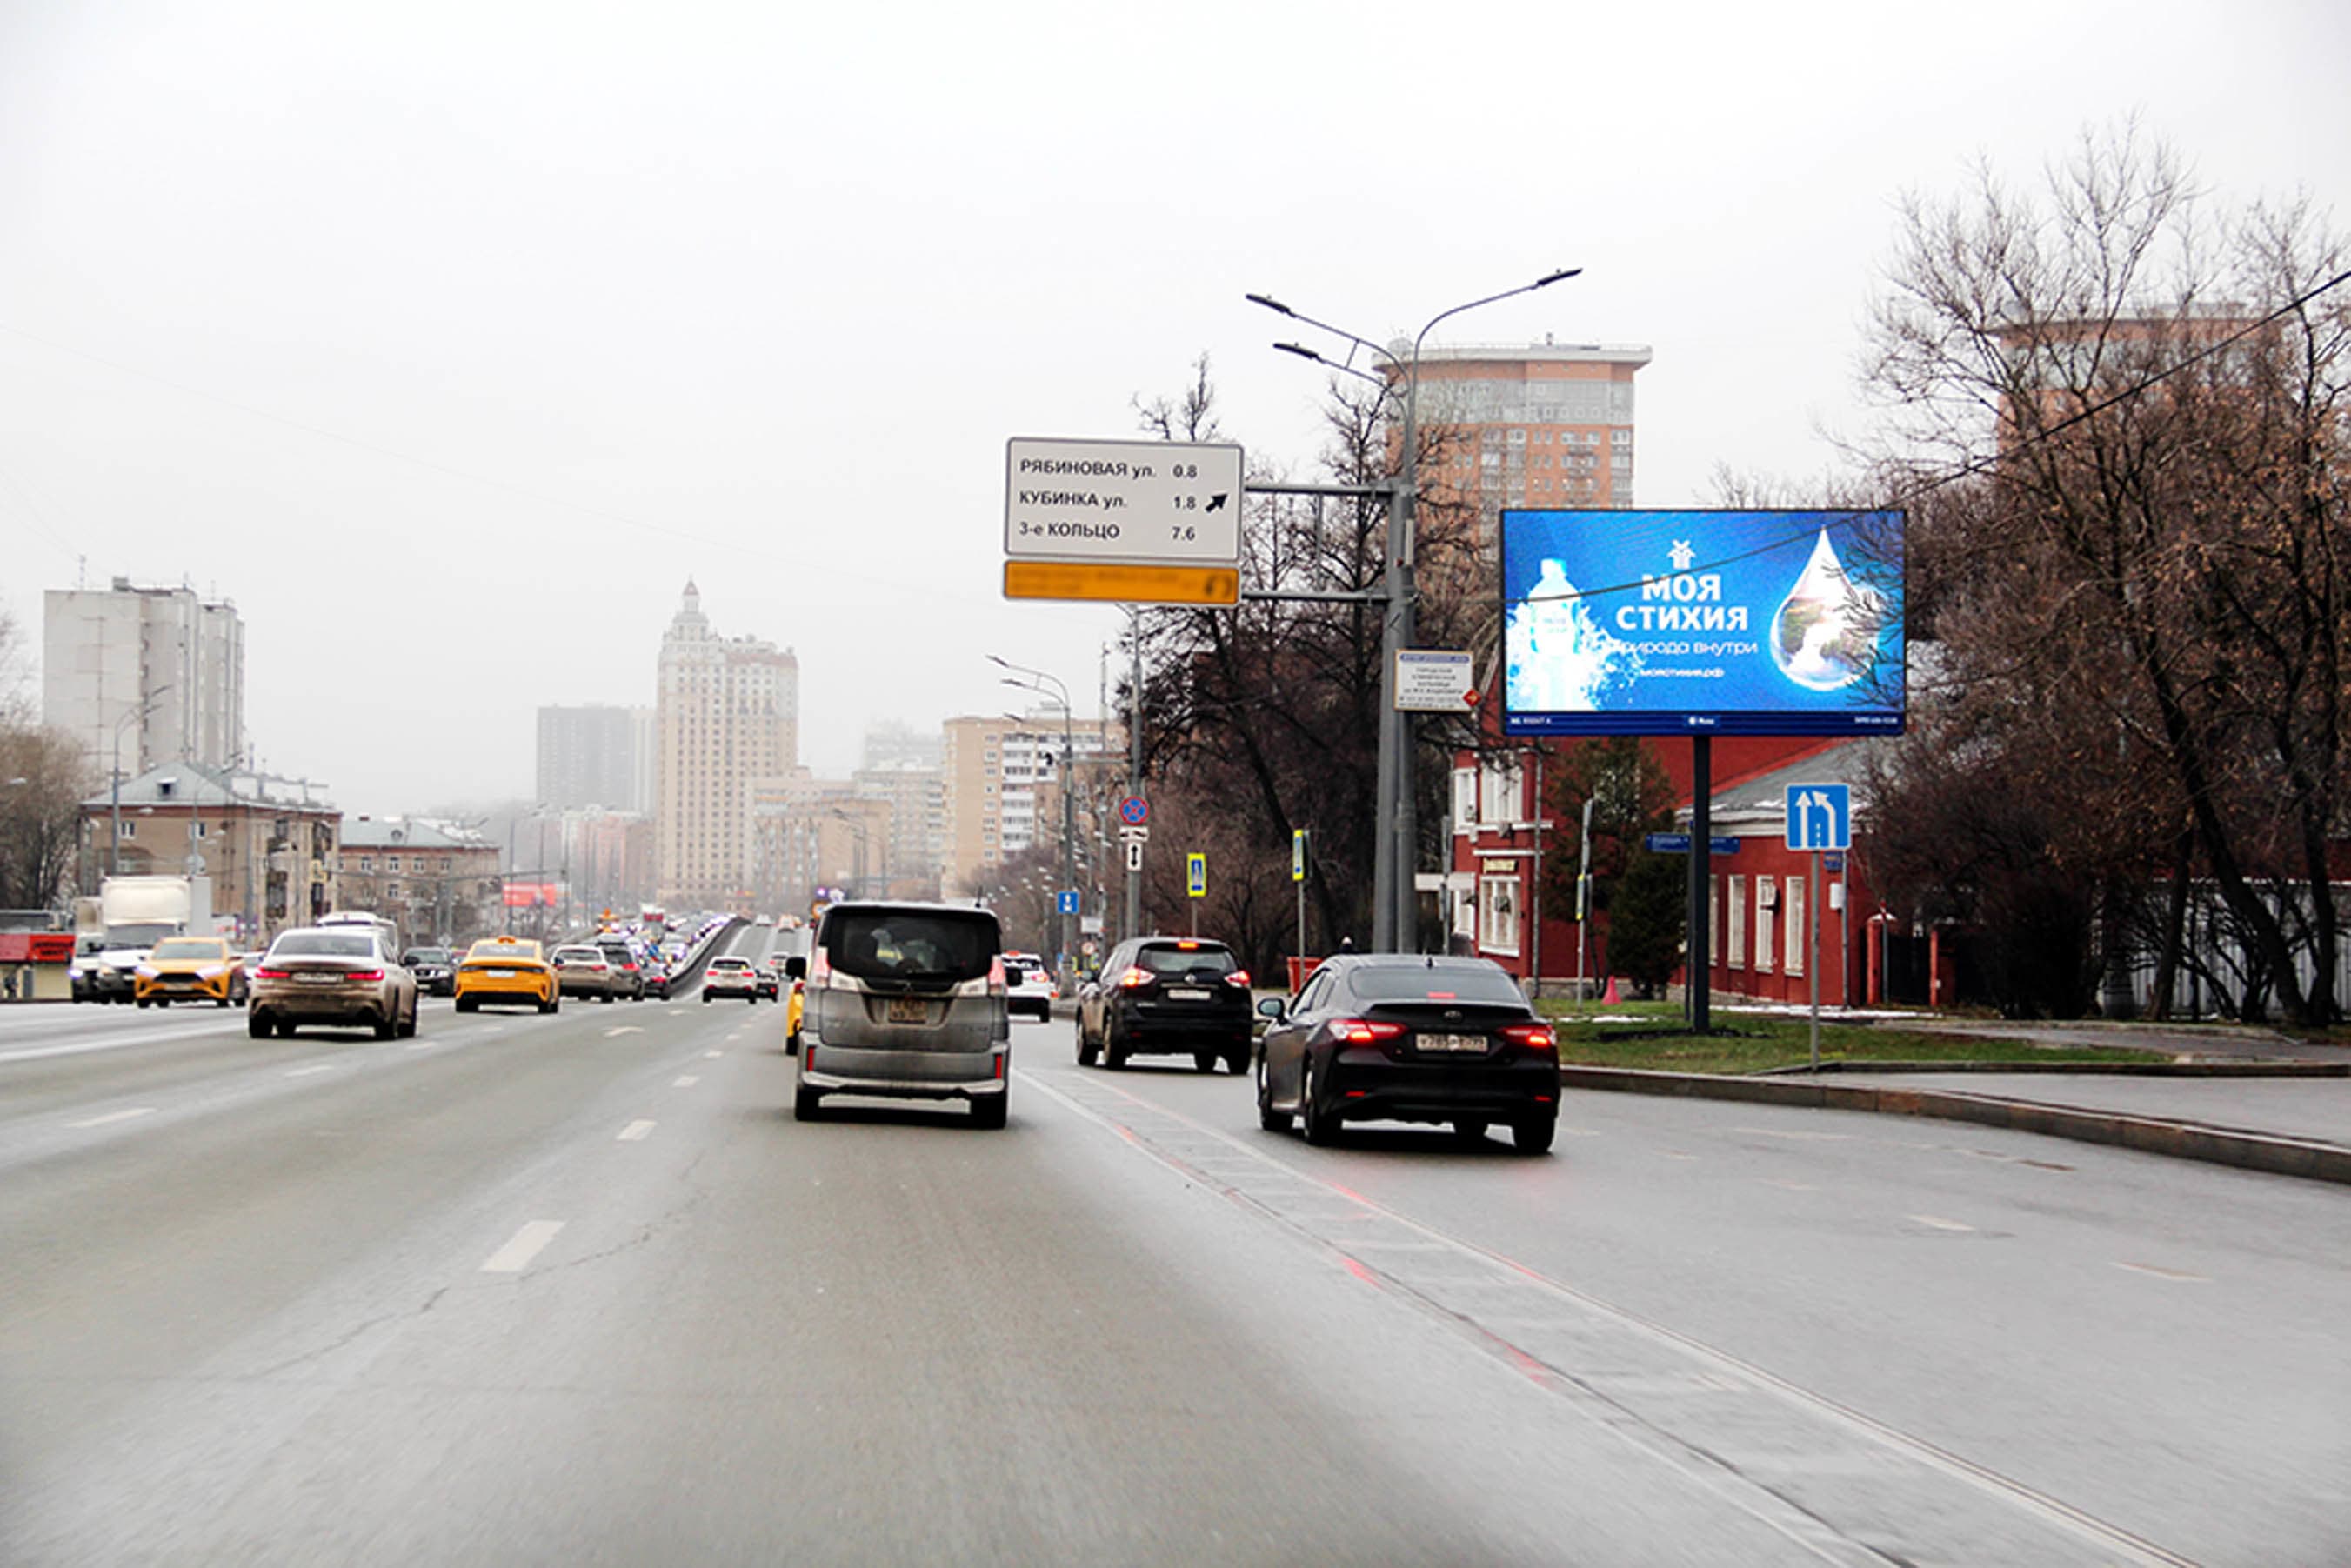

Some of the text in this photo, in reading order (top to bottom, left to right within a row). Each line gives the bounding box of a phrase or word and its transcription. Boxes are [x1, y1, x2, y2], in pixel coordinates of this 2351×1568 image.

[1020, 458, 1198, 480] РЯБИНОВАЯ ул. 0.8
[1019, 490, 1196, 510] КУБИНКА ул. 1.8
[1019, 521, 1196, 541] 3-е КОЛЬЦО 7.6
[1642, 572, 1721, 602] МОЯ
[1616, 604, 1748, 631] СТИХИЯ
[1611, 640, 1758, 657] рирода внутри
